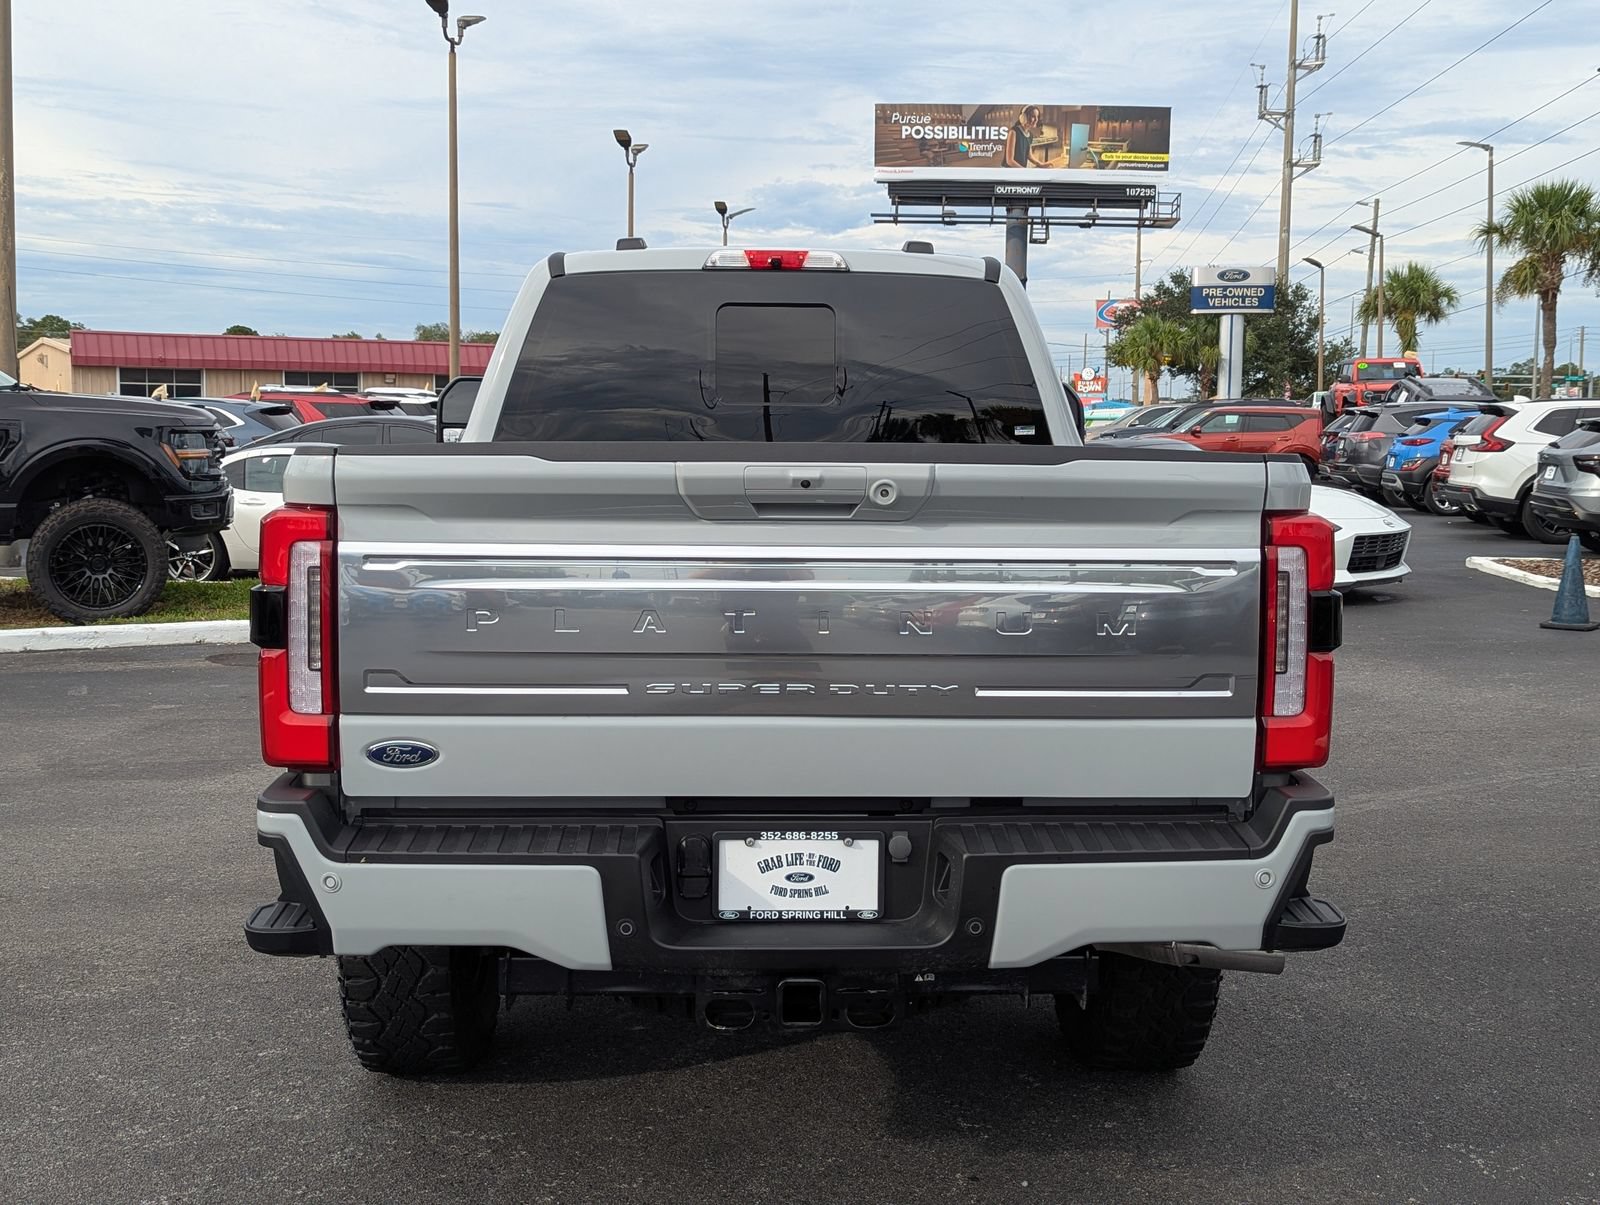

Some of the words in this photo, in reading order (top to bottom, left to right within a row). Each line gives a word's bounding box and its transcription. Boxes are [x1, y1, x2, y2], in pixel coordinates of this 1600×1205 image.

[891, 112, 932, 124] Pursue
[901, 125, 1009, 140] POSSIBILITIES
[968, 142, 1002, 153] Tremfya
[1223, 271, 1245, 280] Ford
[1202, 288, 1265, 297] PRE-OWNED
[1208, 297, 1259, 306] VEHICLES
[1077, 384, 1102, 393] DOWN
[466, 608, 1137, 635] PLATINUM
[646, 683, 815, 696] SUPER
[829, 683, 959, 697] DUTY
[382, 746, 421, 763] Ford
[760, 831, 839, 841] 352-686-8255
[757, 854, 784, 874] GRAB
[785, 852, 805, 867] LIFE
[806, 859, 816, 867] THE
[816, 854, 841, 873] FORD
[790, 873, 810, 882] Ford
[769, 884, 788, 898] FORD
[788, 887, 814, 899] SPRING
[814, 884, 830, 897] HILL
[750, 910, 779, 919] FORD
[781, 910, 822, 919] SPRING
[824, 910, 847, 919] HILL
